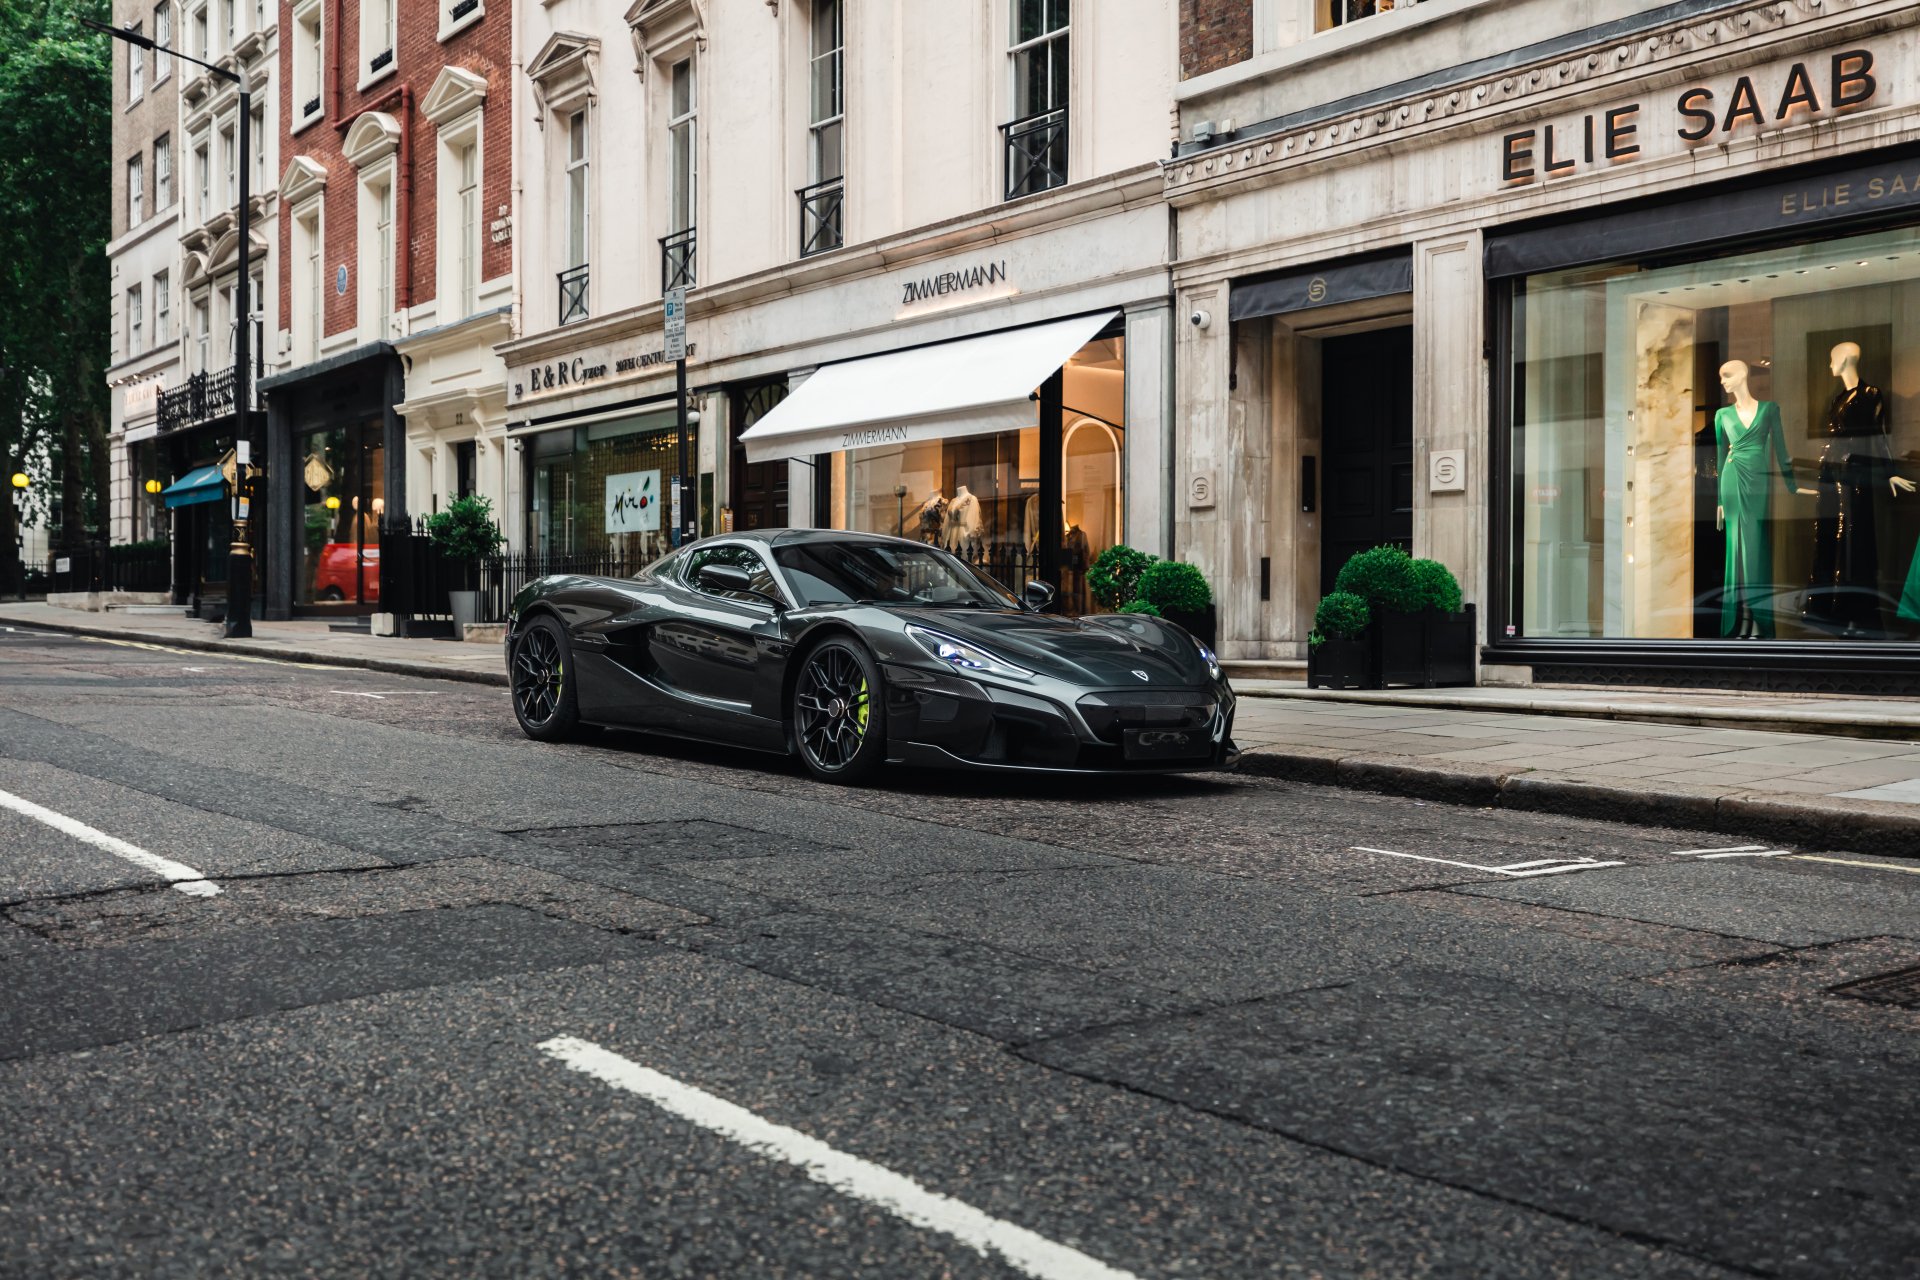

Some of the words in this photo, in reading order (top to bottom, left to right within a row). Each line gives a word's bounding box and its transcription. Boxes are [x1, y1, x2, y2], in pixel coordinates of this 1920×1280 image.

[1503, 103, 1640, 181] ELIE
[1677, 49, 1877, 141] SAAB
[1781, 183, 1850, 214] ELIE
[902, 259, 1006, 304] ZIMMERMANN
[531, 367, 541, 391] E
[543, 364, 555, 389] &
[557, 361, 569, 386] R
[571, 356, 607, 386] Cyzer
[842, 425, 908, 448] ZIMMERMANN
